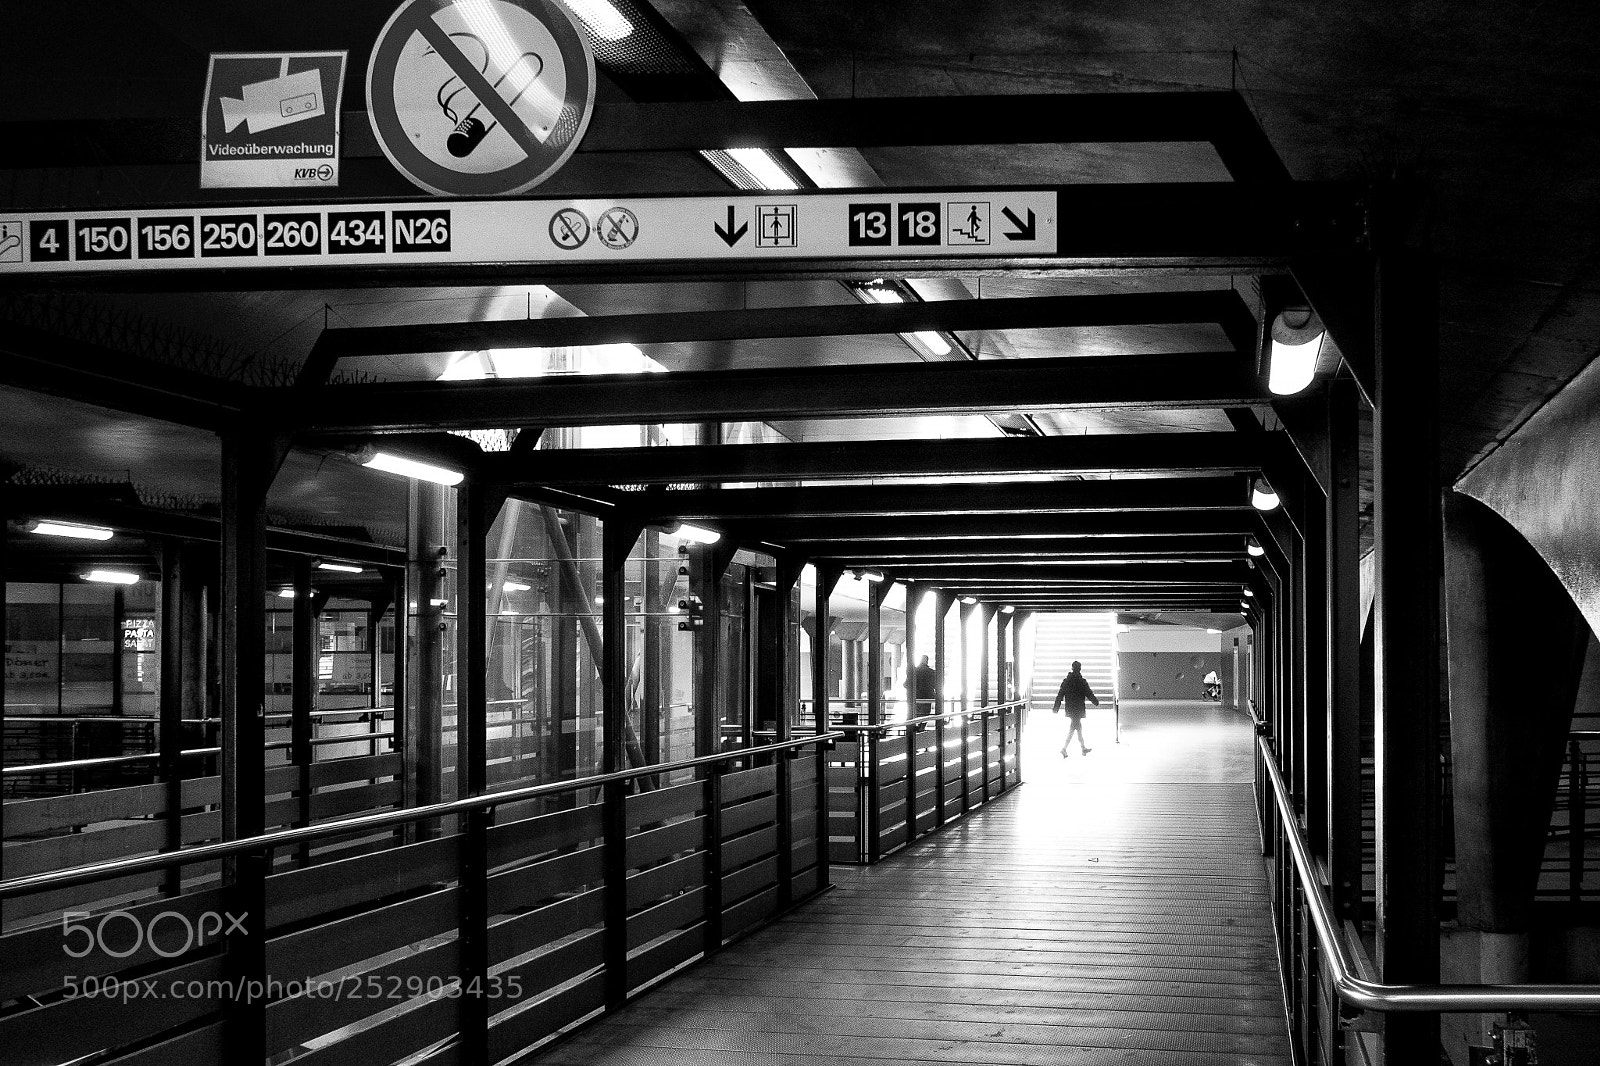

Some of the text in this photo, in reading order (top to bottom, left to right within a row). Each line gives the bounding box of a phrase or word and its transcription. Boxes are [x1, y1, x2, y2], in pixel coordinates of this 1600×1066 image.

[208, 142, 334, 156] Videoüberwachung
[294, 168, 316, 179] KVB
[853, 210, 936, 238] 13 18
[39, 217, 448, 254] 4 150 156 250 260 434 N26
[125, 619, 155, 629] PIZZA
[124, 629, 154, 638] PASTA
